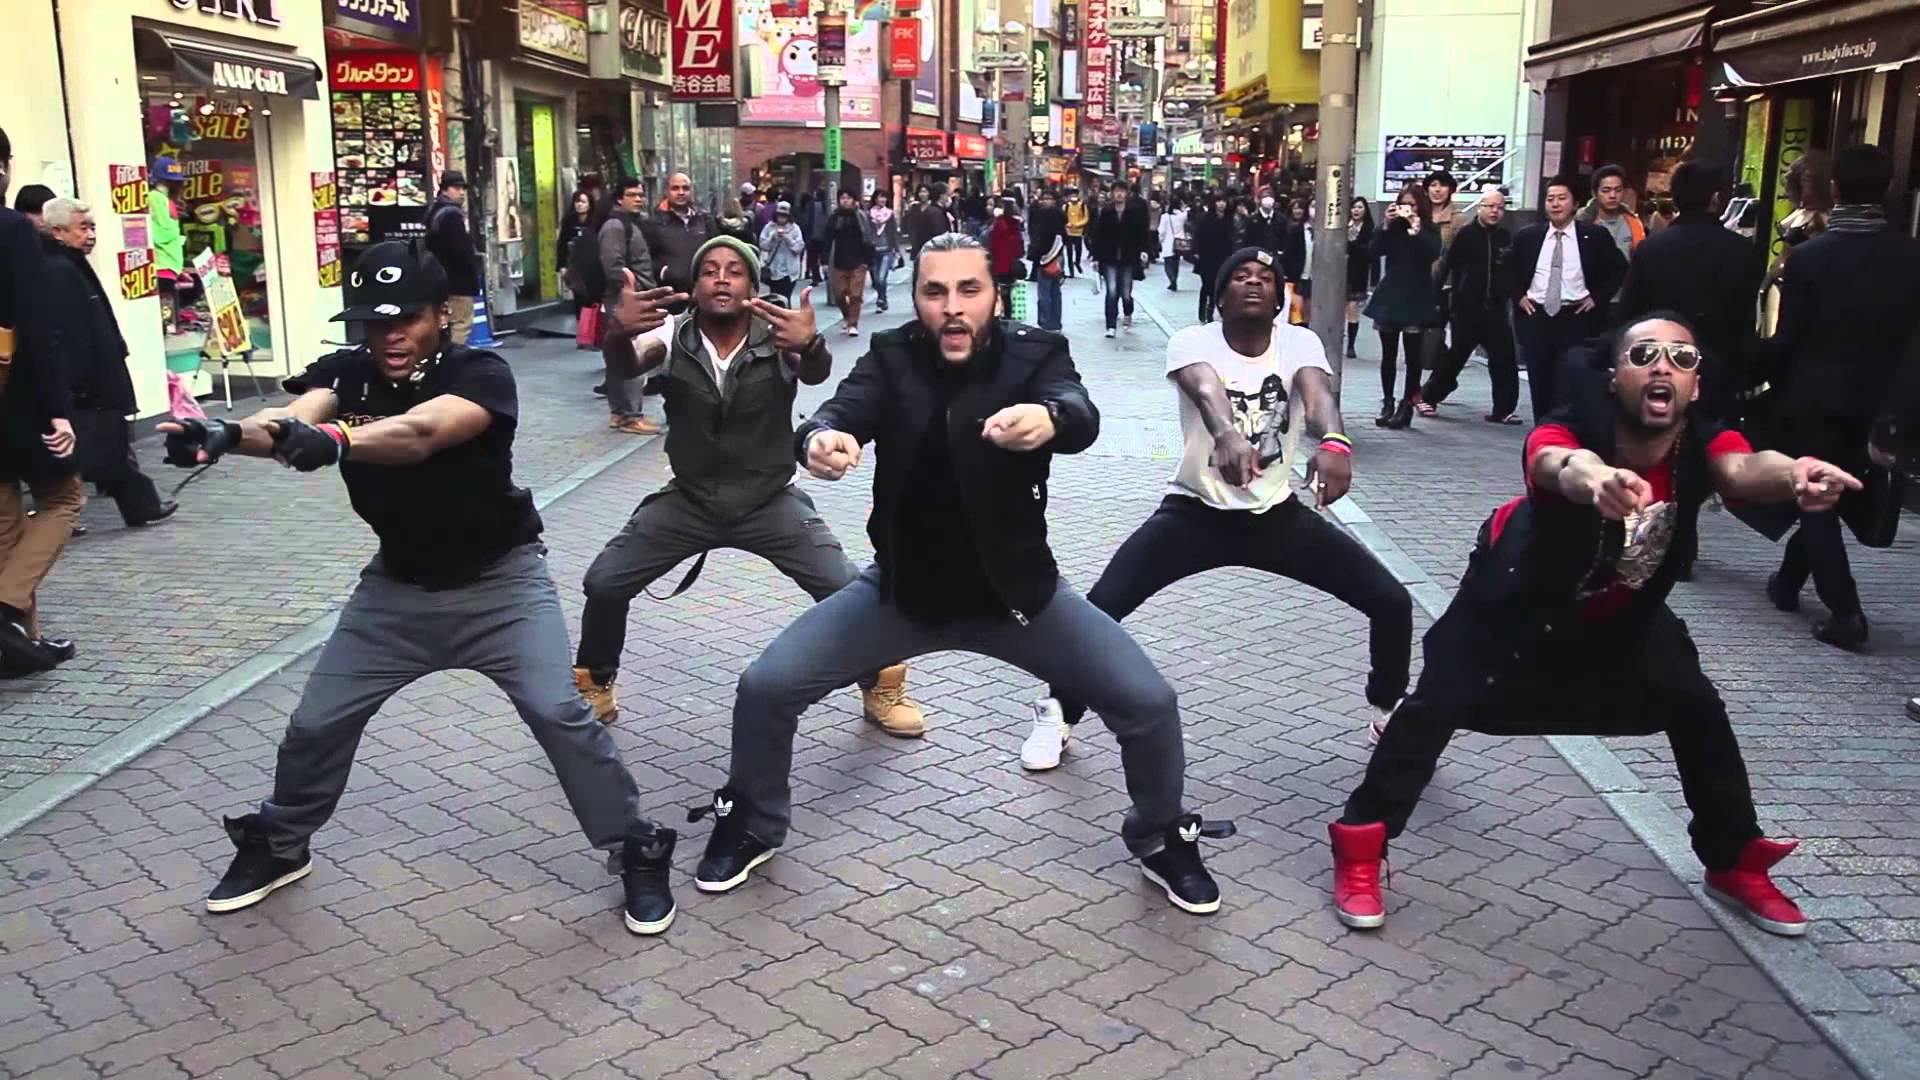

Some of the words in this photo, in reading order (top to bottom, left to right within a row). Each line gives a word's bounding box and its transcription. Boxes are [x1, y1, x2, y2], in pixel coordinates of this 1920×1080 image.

[1802, 38, 1877, 64] www.bodyfocus.jp
[336, 62, 413, 84] グルメタウン
[672, 74, 731, 93] 渋谷会館
